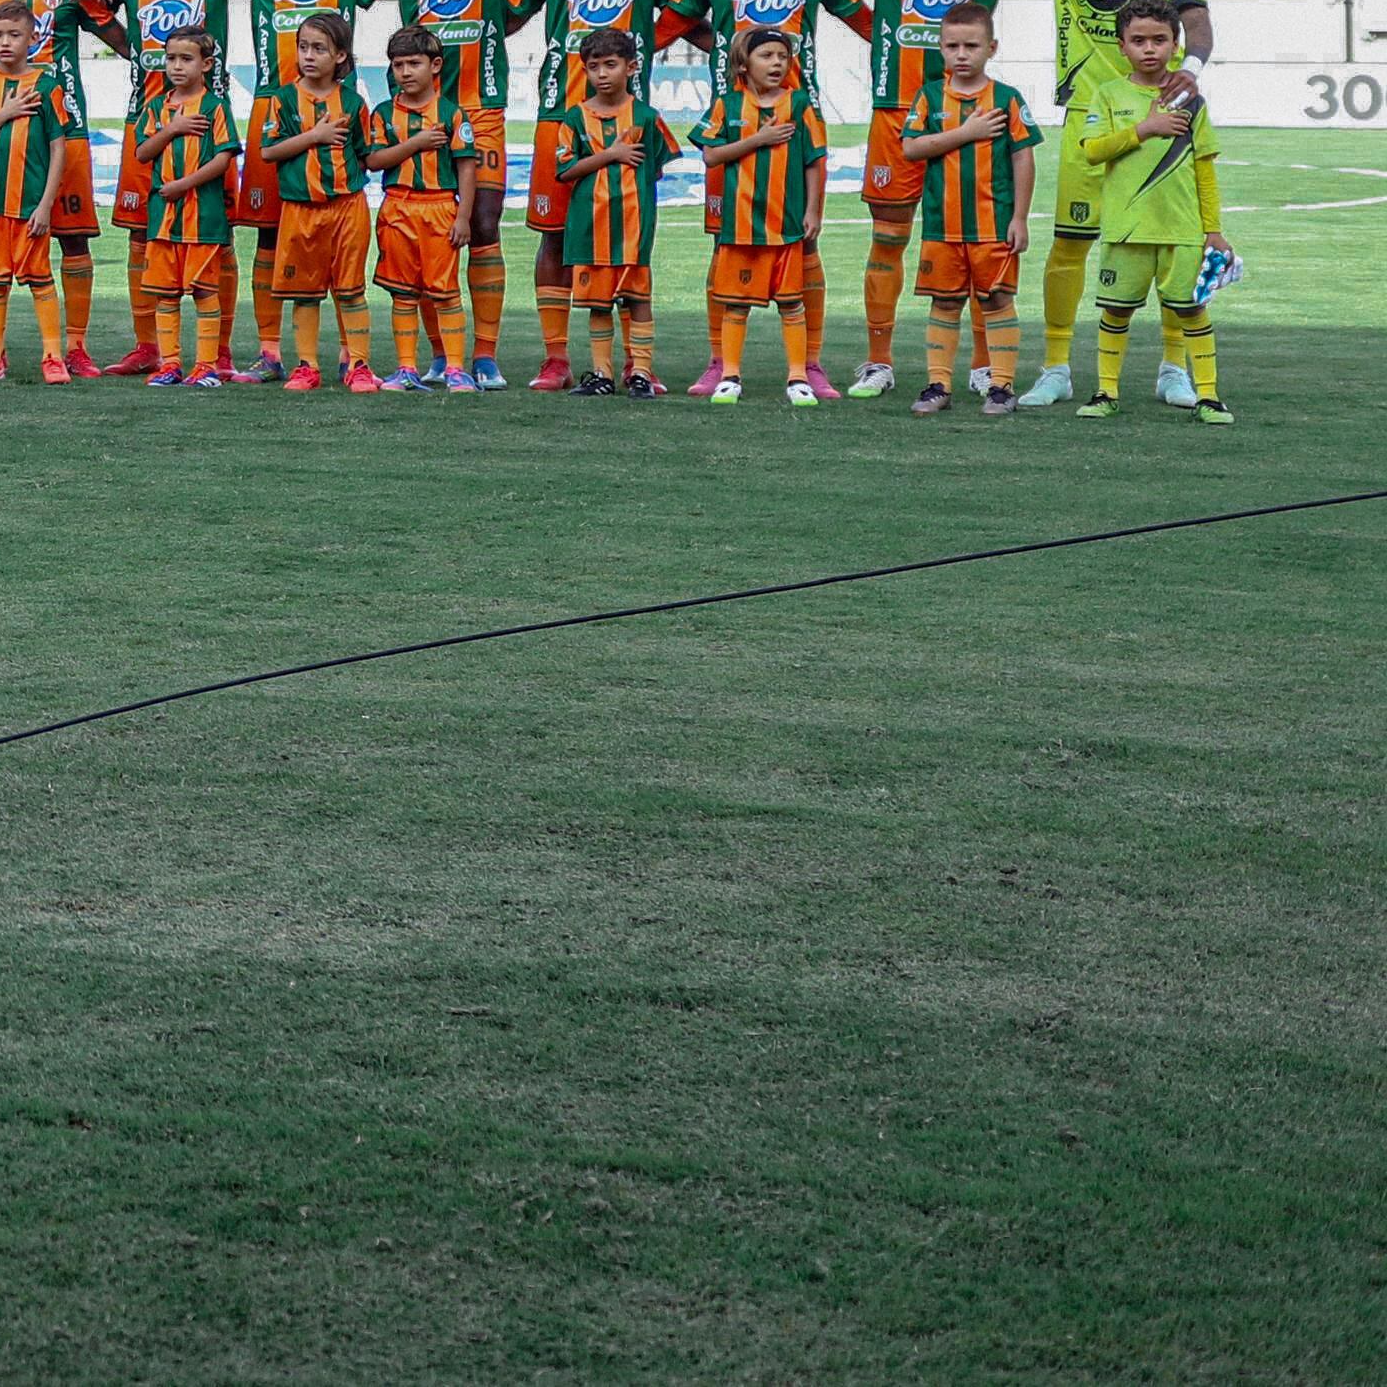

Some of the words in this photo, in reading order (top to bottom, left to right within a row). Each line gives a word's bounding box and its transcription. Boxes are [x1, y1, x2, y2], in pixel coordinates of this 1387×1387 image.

[436, 26, 481, 40] lanta
[898, 29, 940, 43] Cola
[484, 38, 497, 97] BetPlay
[60, 195, 82, 215] 18
